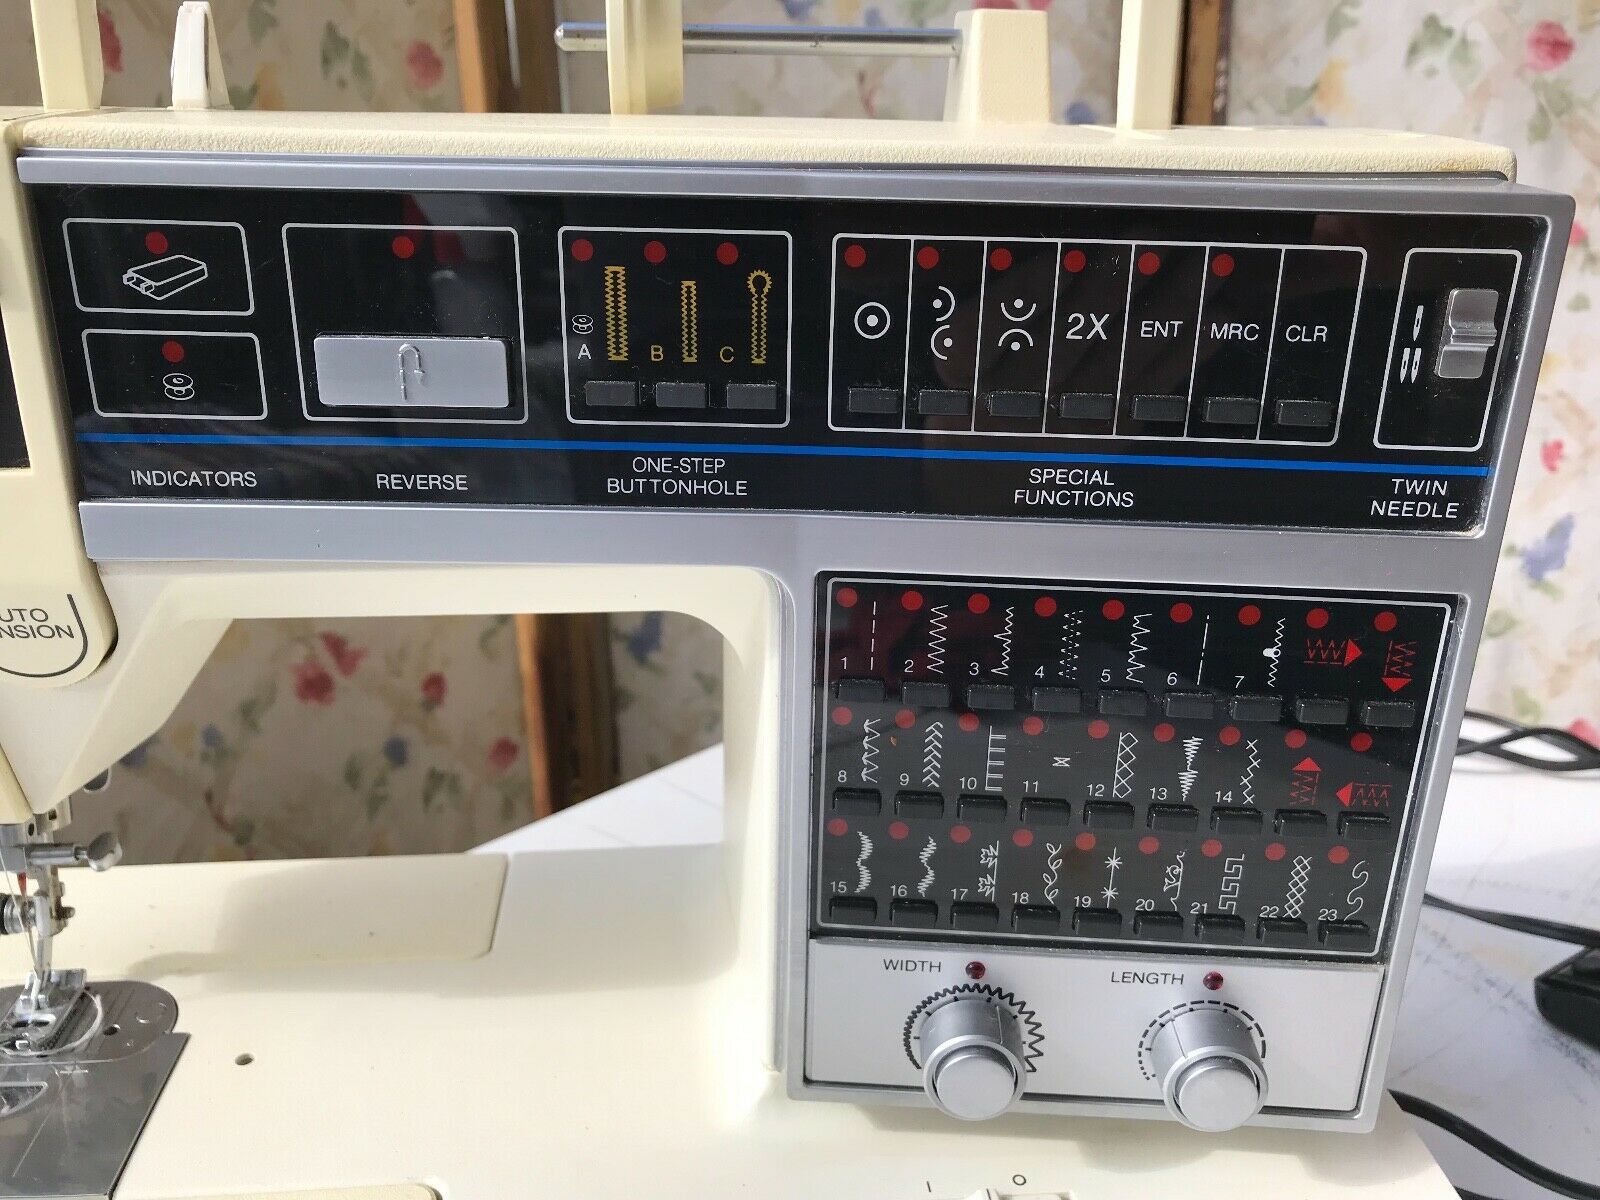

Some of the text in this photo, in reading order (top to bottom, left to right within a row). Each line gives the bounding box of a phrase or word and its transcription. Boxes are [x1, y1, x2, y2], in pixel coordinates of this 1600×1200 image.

[1065, 312, 1110, 340] 2X
[1140, 320, 1183, 338] ENT
[1210, 322, 1260, 341] MRC
[1285, 324, 1328, 343] CLR
[577, 343, 592, 360] A
[650, 344, 664, 362] B
[719, 345, 735, 363] C
[632, 456, 726, 474] ONE-STEP
[130, 469, 258, 488] INDICATORS
[376, 473, 469, 491] REVERSE
[1028, 467, 1115, 486] SPECIAL
[607, 477, 748, 496] BUTTONHOLE
[1391, 478, 1448, 496] TWIN
[1014, 489, 1134, 508] FUNCTIONS
[1370, 499, 1460, 519] NEEDLE
[840, 656, 847, 670] 1
[904, 659, 914, 673] 2
[969, 661, 980, 676] 3
[1034, 665, 1045, 679] 4
[1100, 668, 1111, 683] 5
[1166, 671, 1178, 686] 6
[1234, 675, 1245, 689] 7
[837, 769, 847, 783] 8
[899, 772, 910, 786] 9
[959, 776, 977, 790] 10
[1022, 780, 1039, 793] 11
[1086, 783, 1105, 797] 12
[1149, 786, 1168, 801] 13
[1215, 790, 1233, 803] 14
[830, 880, 847, 894] 15
[890, 884, 908, 897] 16
[950, 888, 969, 901] 17
[1011, 891, 1030, 905] 18
[1073, 895, 1092, 908] 19
[1135, 898, 1155, 912] 20
[1189, 901, 1208, 915] 21
[1259, 905, 1280, 919] 22
[1317, 908, 1338, 922] 23
[883, 958, 942, 973] WIDTH
[1110, 971, 1185, 985] LENGTH
